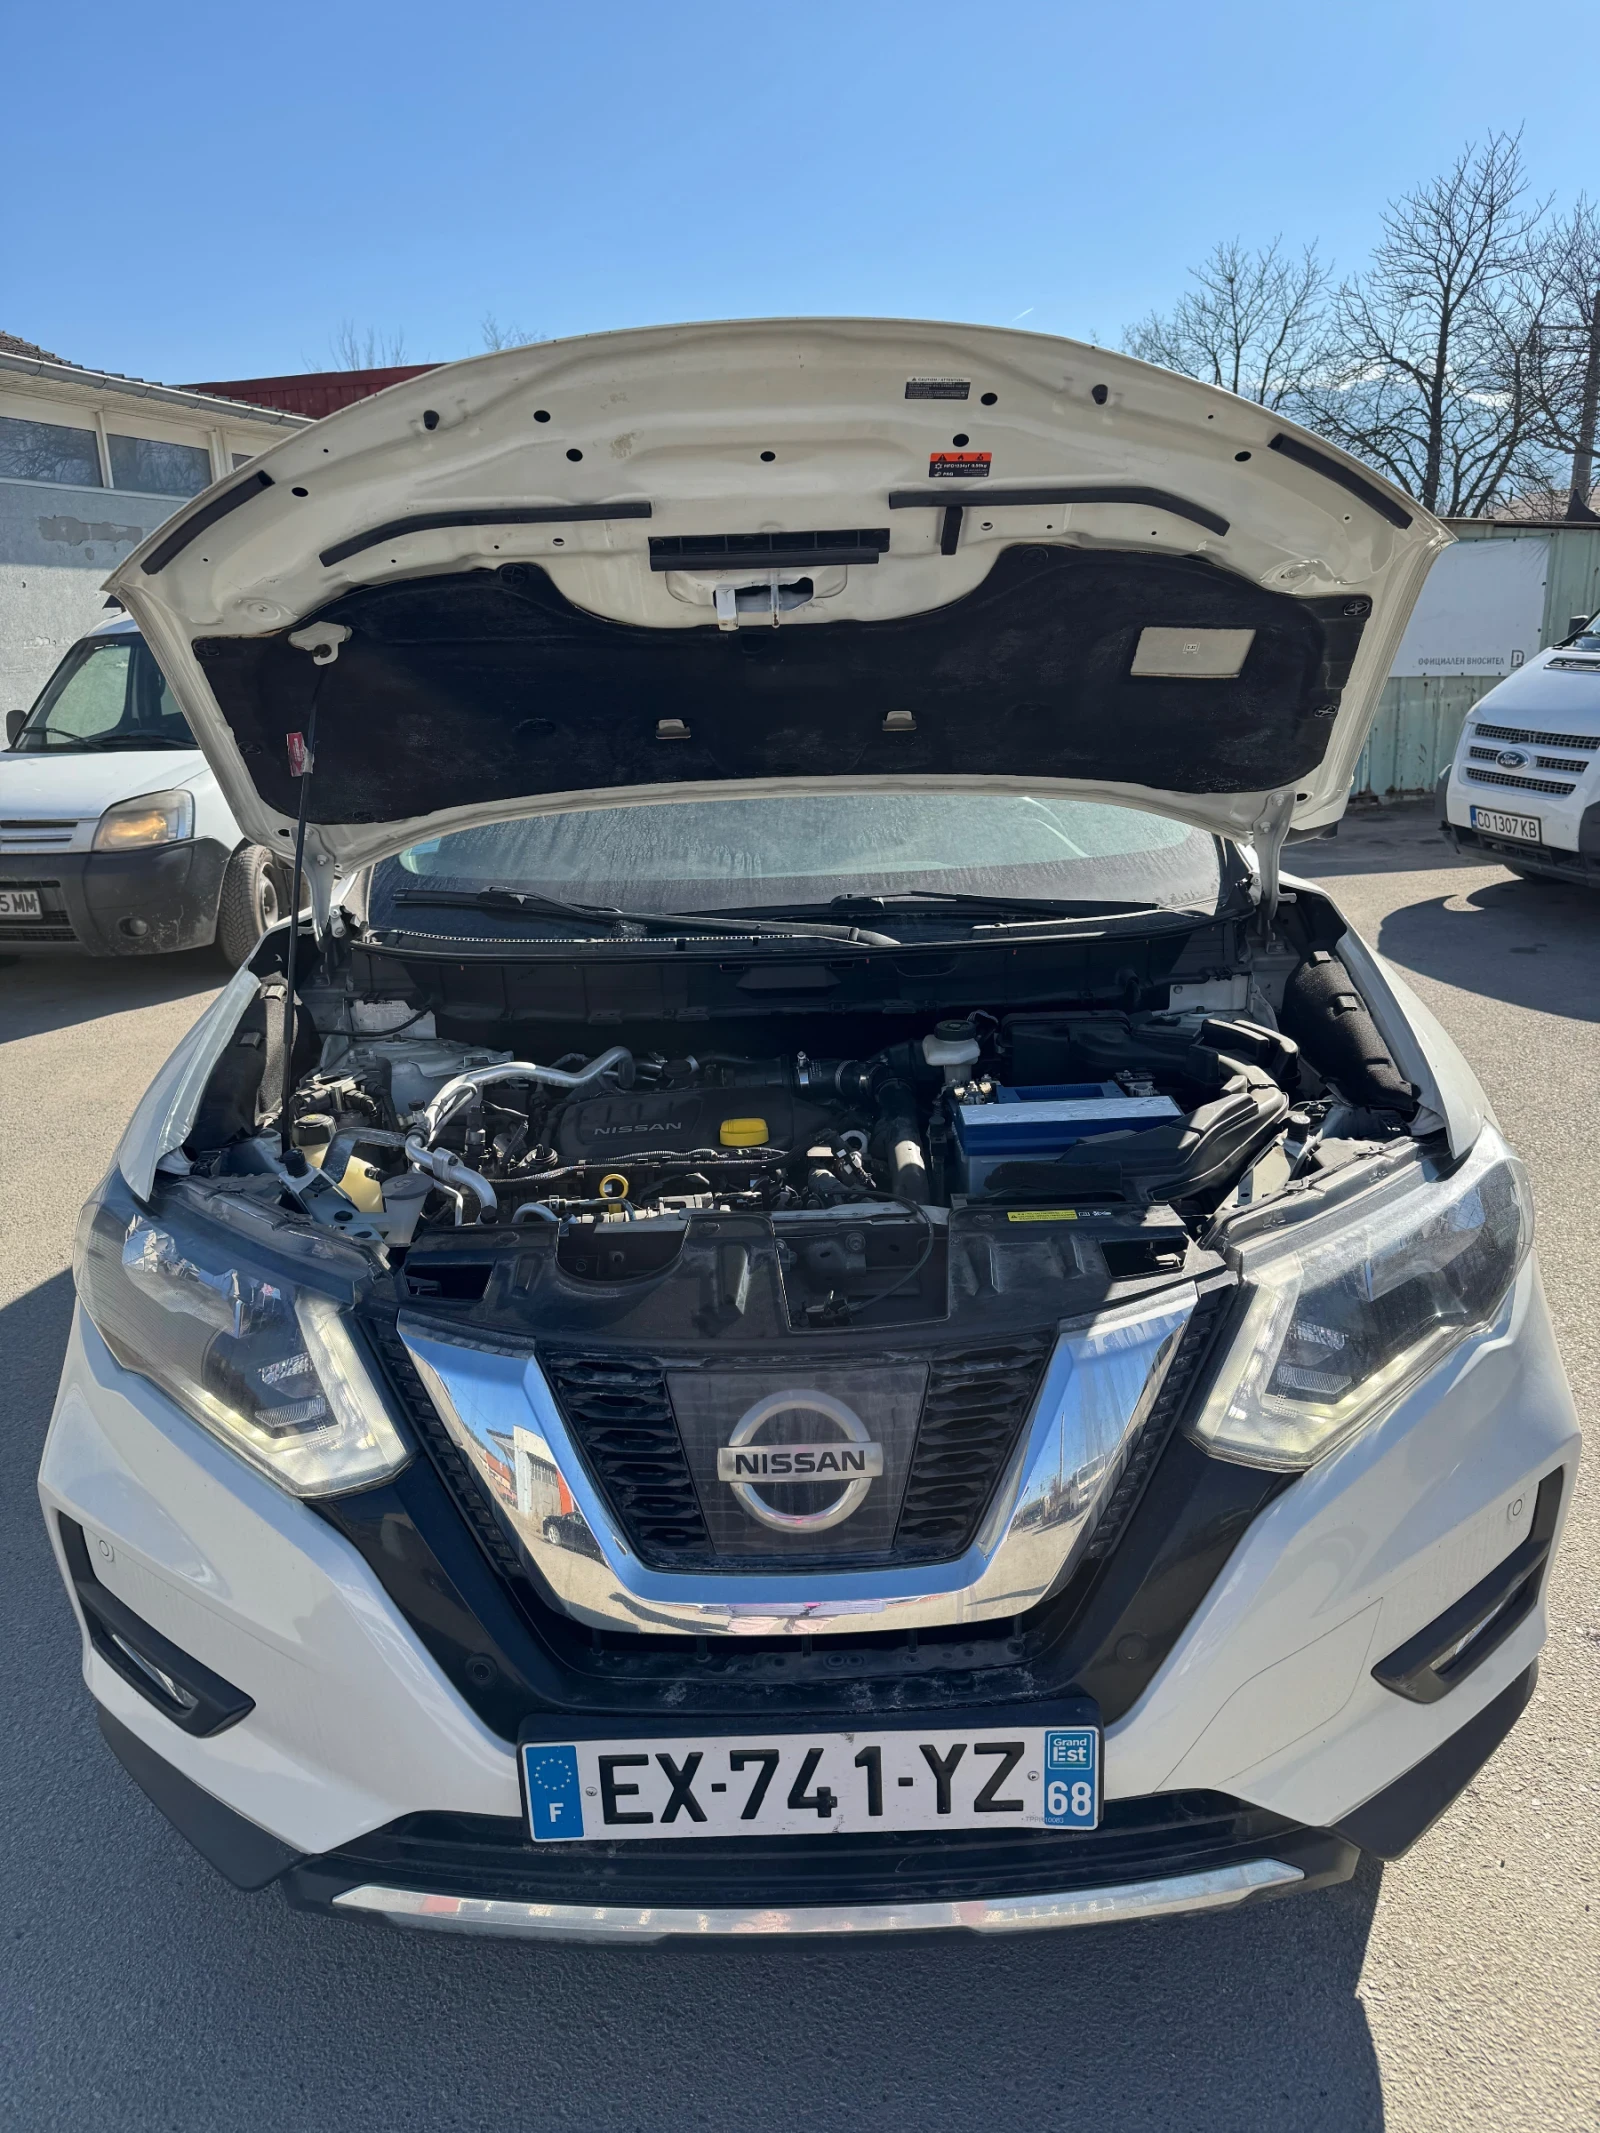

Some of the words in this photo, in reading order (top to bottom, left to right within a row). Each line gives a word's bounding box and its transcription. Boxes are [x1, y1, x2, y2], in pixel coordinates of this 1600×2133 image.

[1418, 656, 1465, 666] ОФИЦИАЛЕН
[1466, 656, 1505, 665] ВНОСИТЕЛ
[1500, 753, 1519, 765] Ford
[1477, 811, 1491, 829] CO
[1493, 815, 1519, 835] 1307
[1520, 820, 1537, 838] KB
[11, 893, 37, 913] MM
[594, 1122, 682, 1135] NISSAN
[735, 1450, 866, 1475] NISSAN
[1053, 1737, 1087, 1747] Grand
[1053, 1746, 1087, 1762] Est
[598, 1741, 1025, 1825] EX-741-YZ
[1047, 1780, 1092, 1817] 68
[549, 1803, 564, 1823] F
